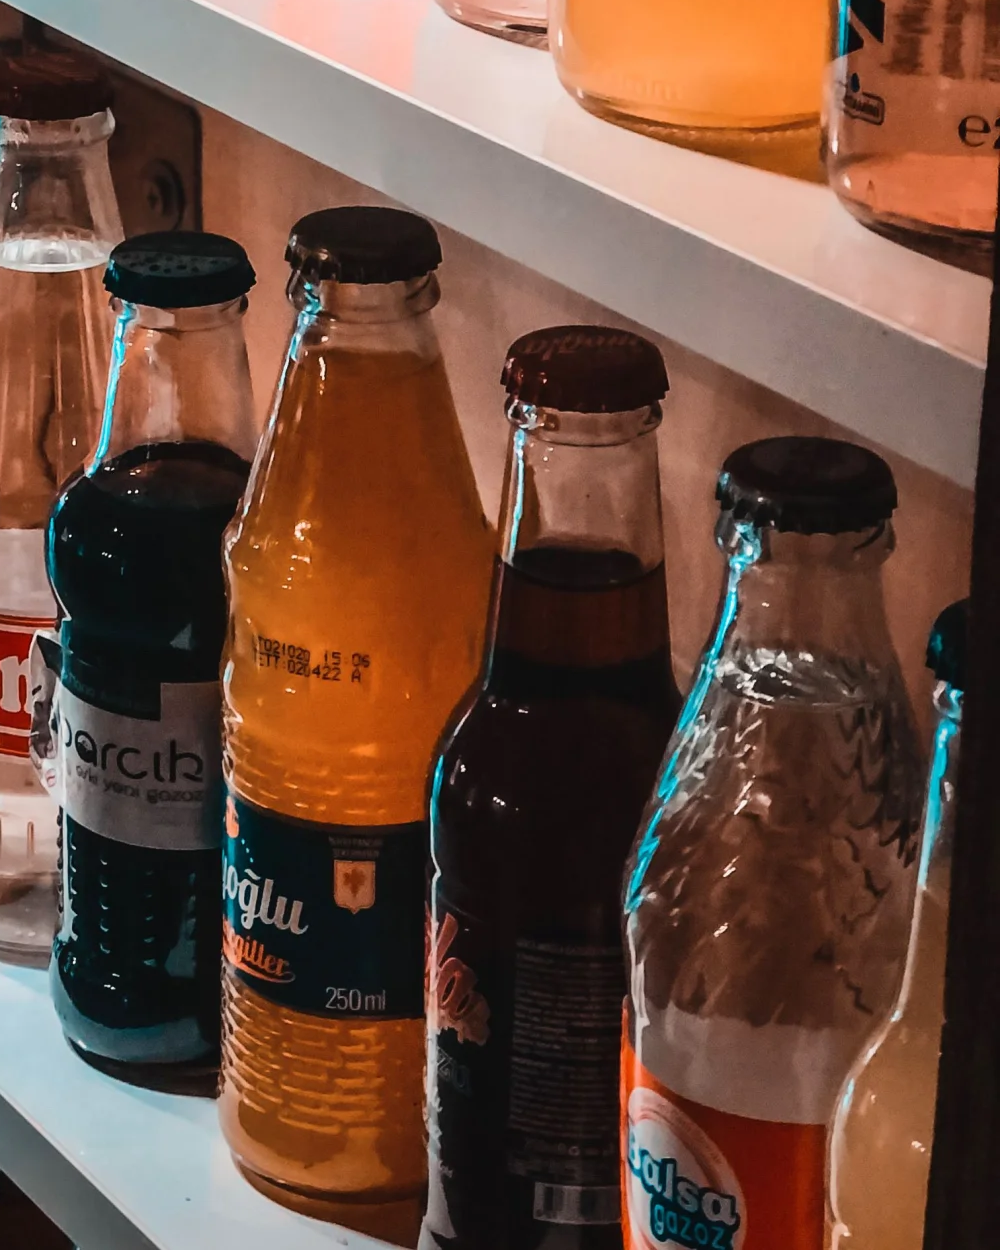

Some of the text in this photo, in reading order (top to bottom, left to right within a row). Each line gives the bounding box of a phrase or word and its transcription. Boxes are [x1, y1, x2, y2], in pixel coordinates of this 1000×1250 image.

[325, 986, 387, 1011] 250 ml
[653, 1204, 727, 1249] gazoz
